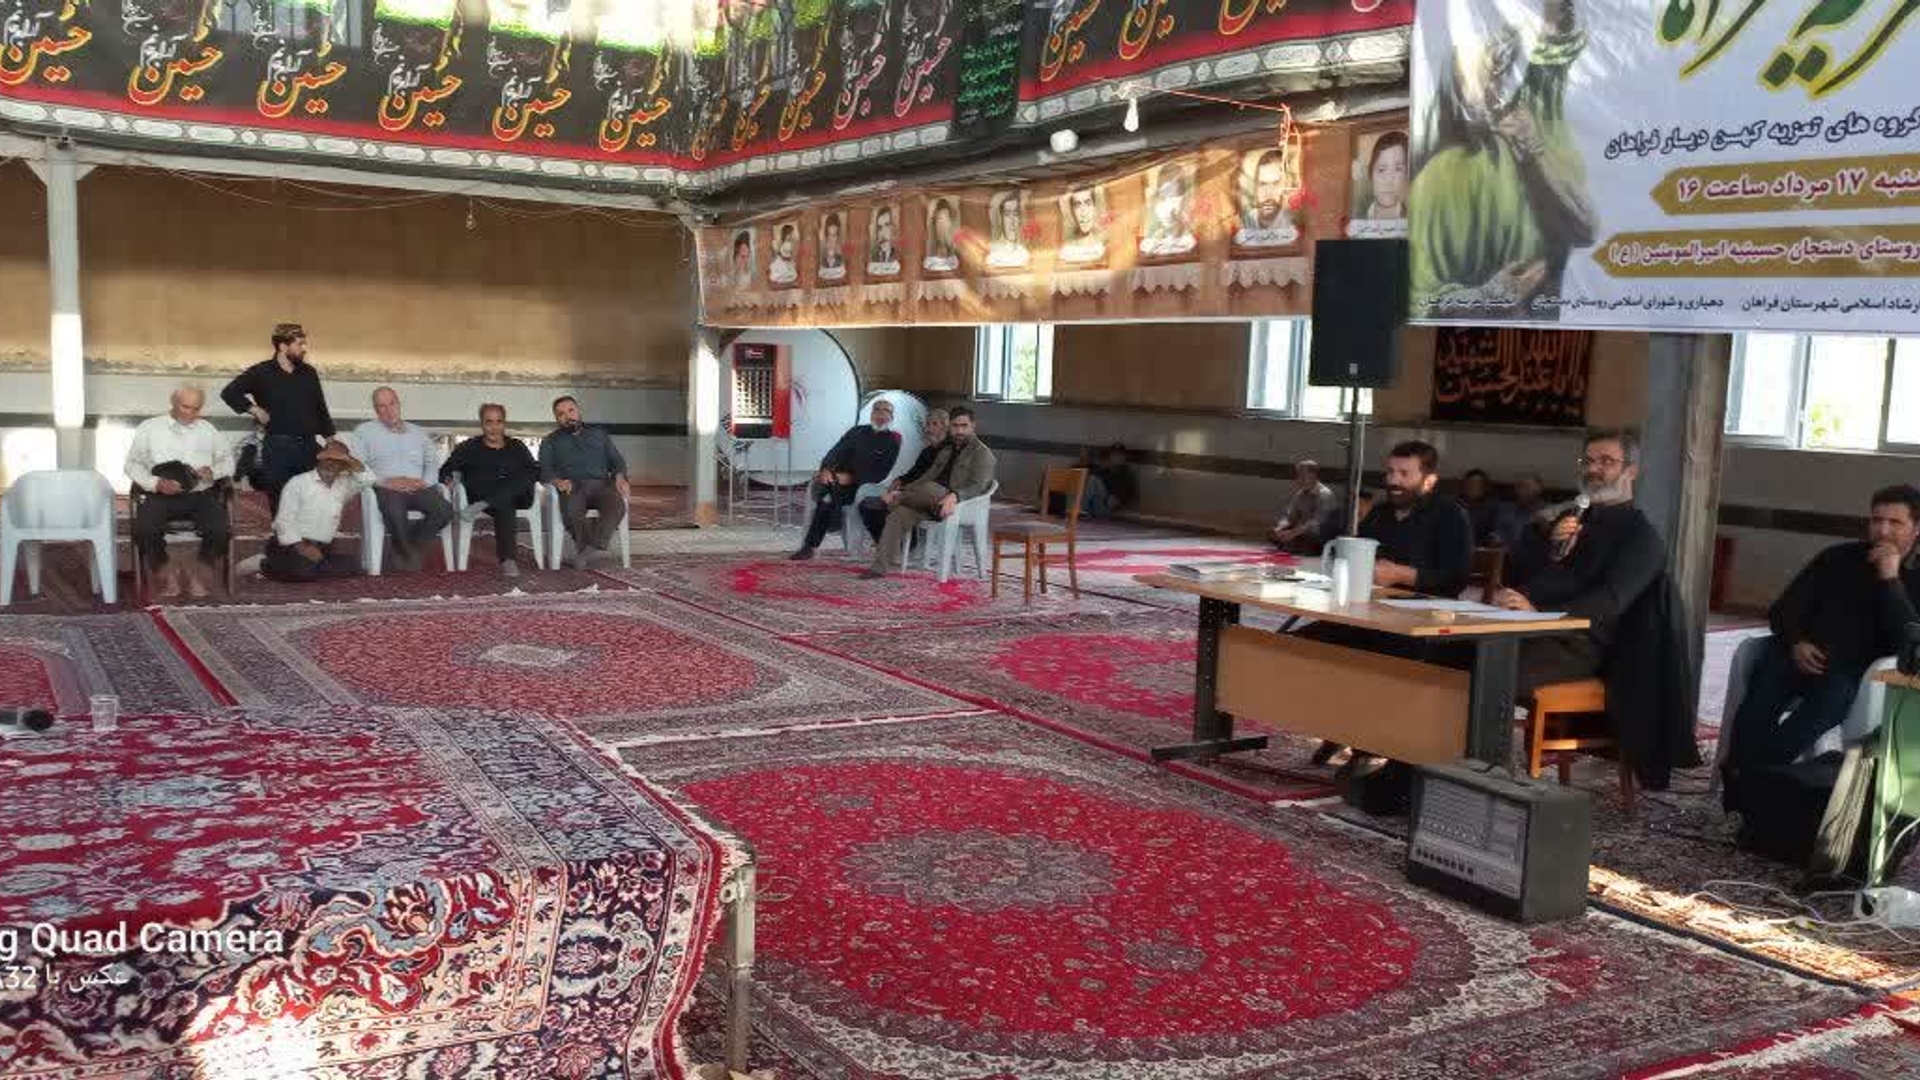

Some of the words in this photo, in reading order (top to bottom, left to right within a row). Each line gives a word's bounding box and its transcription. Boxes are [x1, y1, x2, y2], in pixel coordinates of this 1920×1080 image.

[128, 47, 223, 105] حسین
[257, 61, 347, 118] حسین
[378, 74, 461, 131] حسین
[492, 88, 571, 142] حسین
[600, 97, 671, 152] حسین
[1825, 112, 1870, 142] های
[1661, 127, 1709, 154] دیار
[1711, 120, 1767, 150] کهن
[1768, 117, 1823, 144] تعزیه
[1604, 130, 1660, 159] فراهان
[1678, 179, 1698, 201] ۱۶
[1707, 176, 1765, 198] ساعت
[1773, 174, 1828, 200] مرداد
[1837, 170, 1863, 192] ۱۷
[1729, 240, 1785, 261] حسینیه
[1790, 238, 1854, 263] دستجان
[1643, 296, 1676, 311] شورای
[1684, 296, 1724, 311] دهیاری
[1741, 296, 1778, 312] فراهان
[1780, 296, 1839, 313] شهرستان
[1840, 296, 1886, 313] اسلامی
